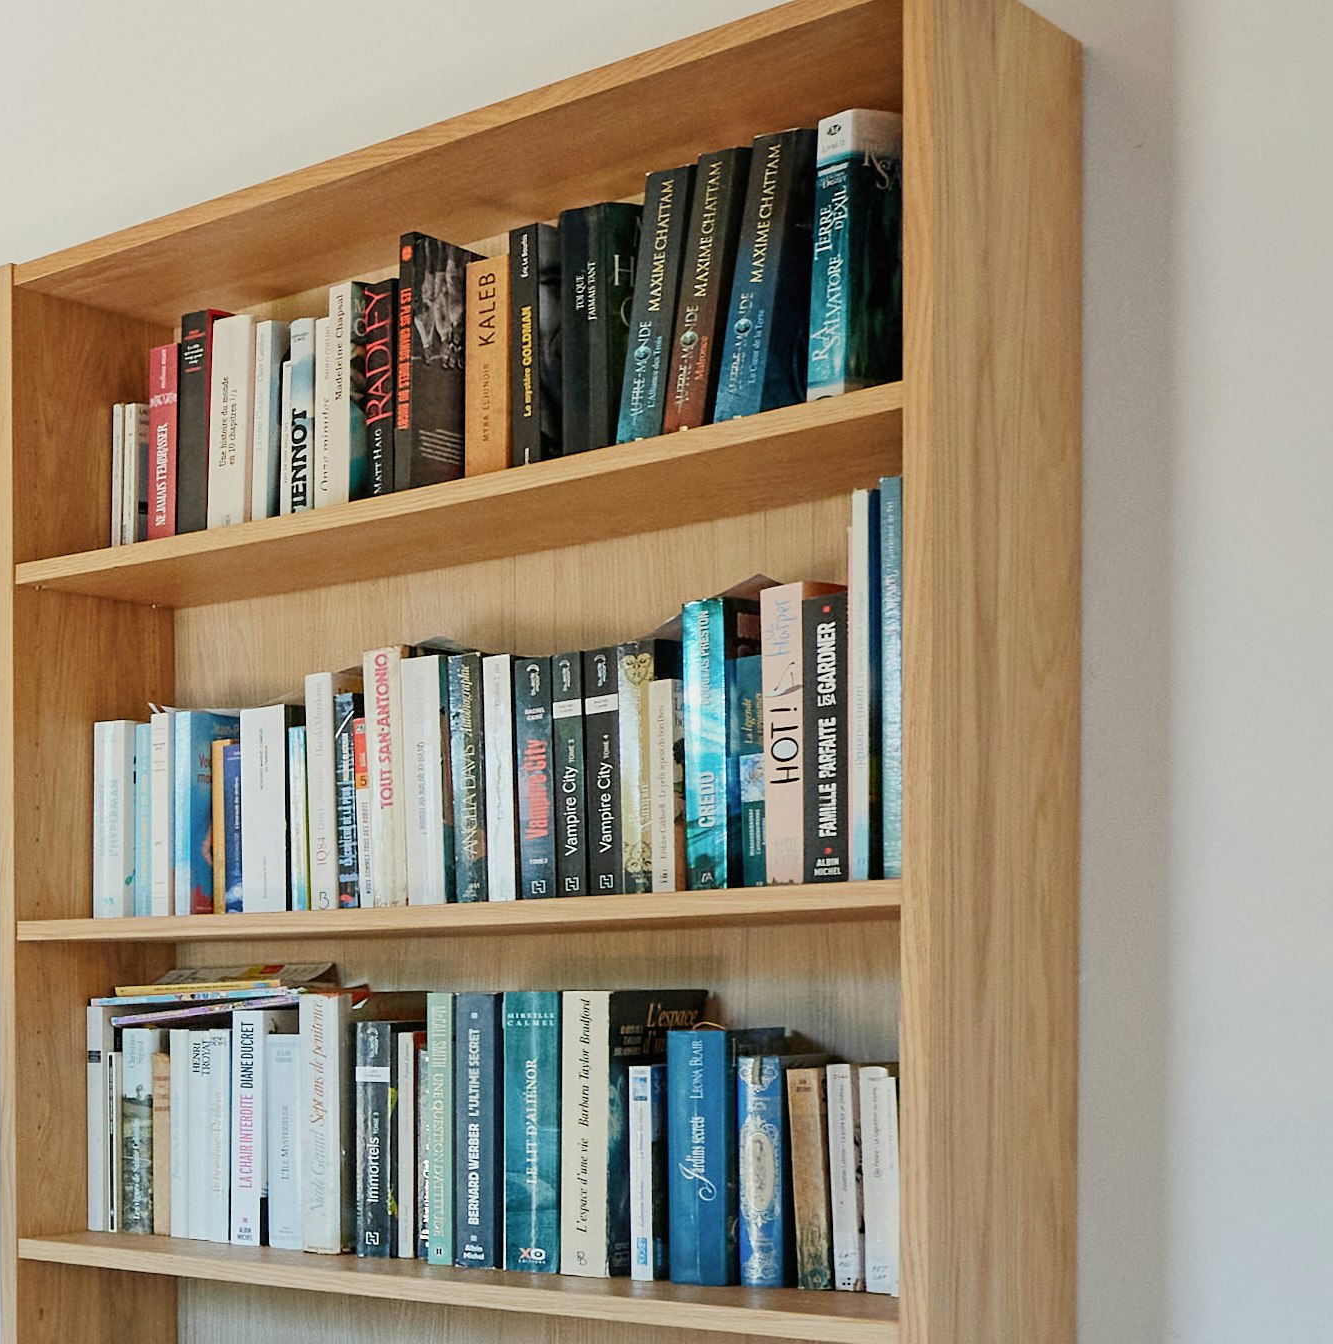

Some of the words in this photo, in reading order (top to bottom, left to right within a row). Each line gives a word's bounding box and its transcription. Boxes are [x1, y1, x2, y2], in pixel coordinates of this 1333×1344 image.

[702, 161, 723, 233] CHATTAM
[759, 144, 781, 218] CHATTAM
[655, 179, 675, 250] CHATTAM
[694, 237, 713, 296] MAXIME
[750, 221, 771, 283] MAXIME
[576, 275, 585, 293] QUE
[576, 295, 585, 310] TOI
[648, 252, 666, 311] MAXIME
[335, 294, 345, 338] Chapsal
[478, 272, 496, 346] KALEB
[335, 343, 343, 400] Madeleine
[365, 287, 393, 425] RADLEY
[221, 405, 228, 415] du
[157, 423, 169, 481] T'EMBRASSER
[219, 451, 227, 466] Une
[373, 429, 382, 459] HAIG
[156, 482, 167, 513] JAMAIS
[373, 462, 382, 494] MATT
[156, 513, 166, 526] NE
[698, 611, 710, 658] PRESTON
[817, 621, 837, 693] GARDNER
[699, 660, 711, 706] DOUGLAS
[818, 717, 837, 778] PARFAITE
[562, 766, 579, 793] City
[597, 762, 613, 789] City
[697, 771, 716, 827] CREDO
[819, 783, 837, 837] FAMILLE
[562, 797, 580, 855] Vampire
[597, 793, 614, 853] Vampire
[241, 1021, 254, 1059] DUCRET
[579, 999, 592, 1044] Bradford
[192, 1043, 201, 1073] HENRI
[469, 1028, 480, 1066] SECRET
[578, 1049, 591, 1080] Taylor
[240, 1060, 254, 1089] DIANE
[469, 1069, 480, 1117] L'ULTIME
[240, 1094, 254, 1143] INTERDITE
[578, 1085, 590, 1126] Barbara
[240, 1145, 253, 1174] CHAIR
[469, 1123, 480, 1169] WERBER
[577, 1138, 589, 1153] vie
[240, 1176, 252, 1188] LA
[576, 1156, 589, 1185] d'une
[469, 1172, 480, 1225] BERNARD
[576, 1188, 589, 1233] L'espace
